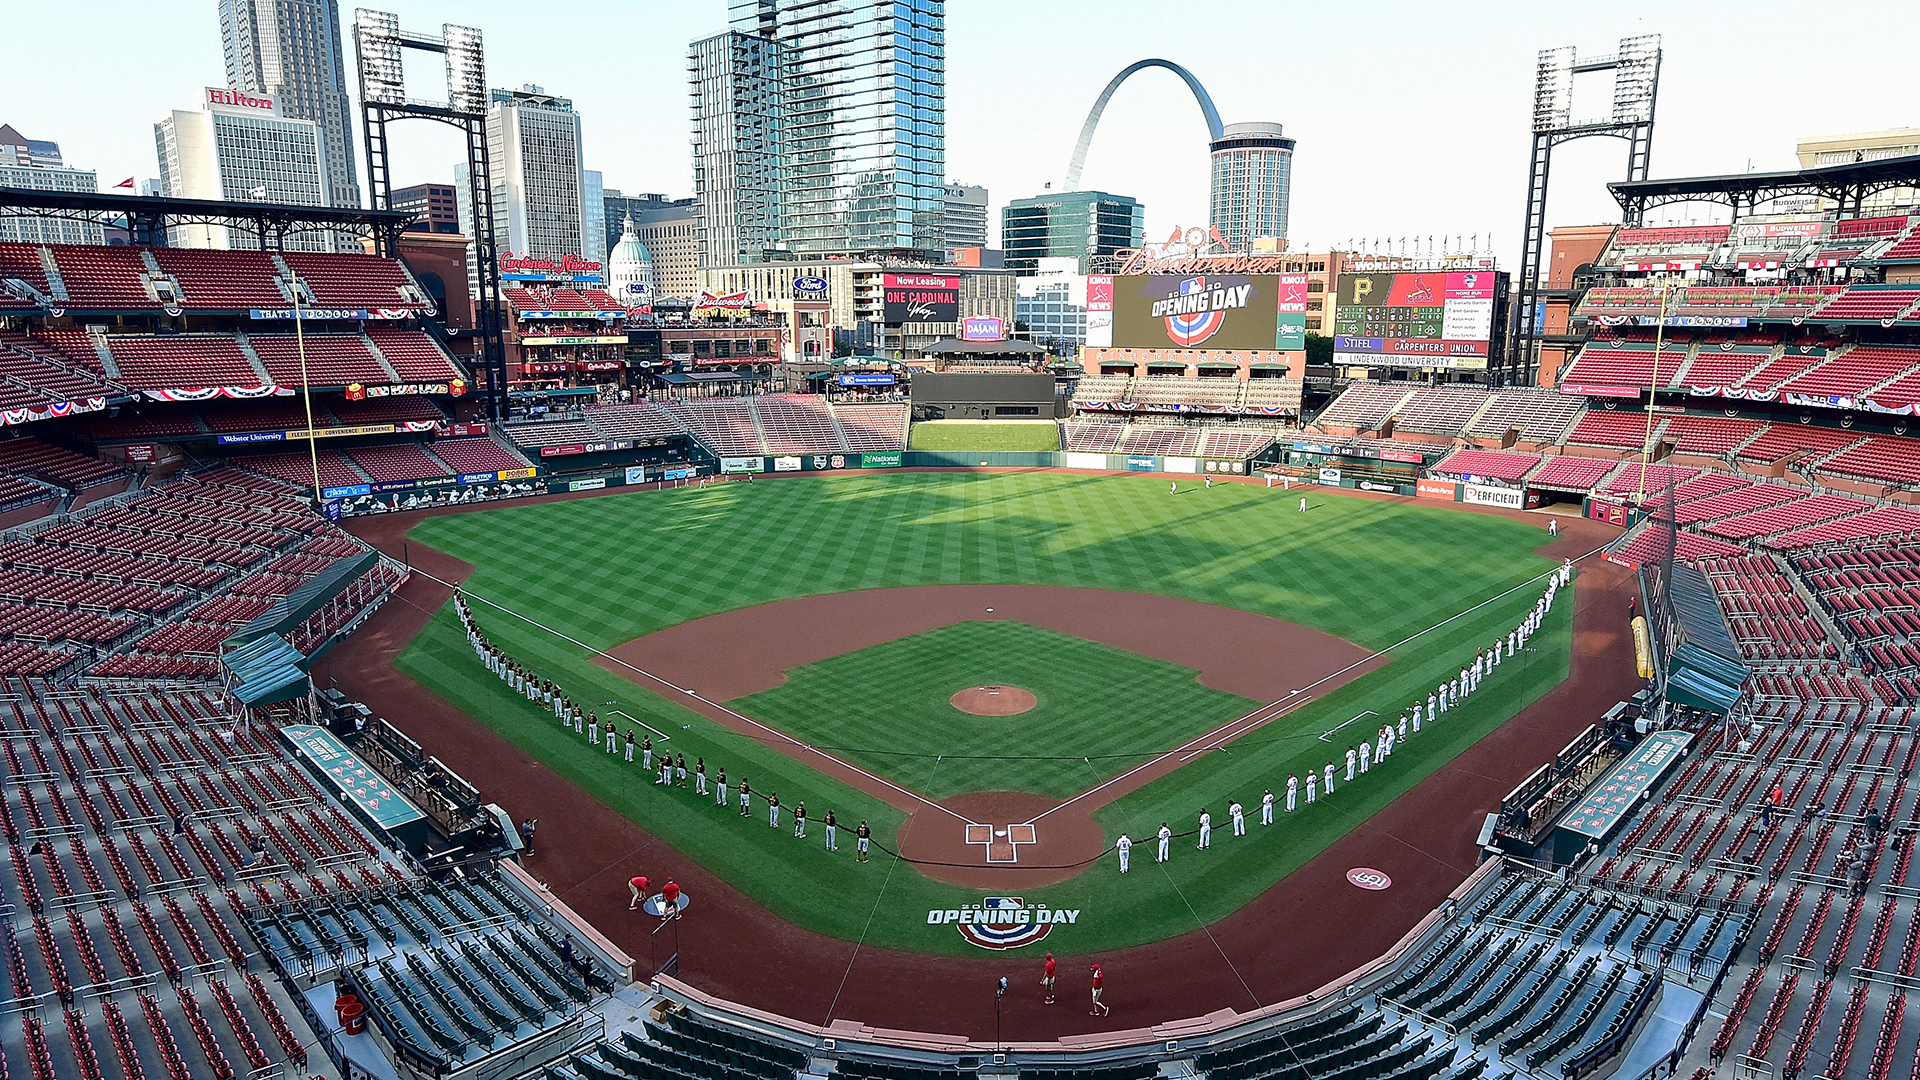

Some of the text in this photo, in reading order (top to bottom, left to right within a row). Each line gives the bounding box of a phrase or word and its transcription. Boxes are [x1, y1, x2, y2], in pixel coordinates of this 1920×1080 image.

[209, 90, 272, 109] Hilton
[1773, 199, 1819, 207] BUDWEISER
[1769, 224, 1816, 232] BUDWEISER
[500, 251, 601, 273] Cardinals Nation
[1113, 248, 1284, 276] Budweiser
[1354, 260, 1399, 271] WORLD
[800, 277, 822, 290] Ford
[896, 276, 946, 288] Now Leasing
[1089, 276, 1111, 285] KMOX
[1281, 276, 1306, 285] KMOX
[1206, 282, 1222, 291] 20
[887, 291, 956, 304] ONE CARDINAL
[1151, 283, 1251, 318] OPENING DAY
[1168, 291, 1179, 299] 20
[692, 294, 750, 309] Budweiser
[1088, 302, 1111, 311] NEWS
[1280, 302, 1305, 312] NEWS
[259, 310, 291, 318] THAT'S
[692, 308, 750, 318] BREW HOUSE
[907, 298, 937, 320] Way
[967, 322, 999, 335] DASANI
[1343, 337, 1373, 349] STIFEL
[1394, 342, 1476, 353] CARPENTERS UNION
[1130, 352, 1137, 361] 6
[1142, 352, 1149, 361] 9
[1154, 353, 1163, 361] 10
[1167, 353, 1177, 361] 14
[1182, 353, 1192, 362] 17
[1213, 354, 1226, 363] 24
[1231, 354, 1243, 363] 42
[1248, 354, 1260, 363] 45
[1266, 355, 1278, 363] 85
[1350, 355, 1400, 365] LINDENWOOD
[1402, 357, 1451, 367] UNIVERSITY
[1563, 386, 1577, 394] Mercy
[223, 432, 282, 443] Webster University
[325, 428, 357, 436] CONVENIENCE
[872, 454, 899, 463] National
[463, 473, 492, 481] ATHLETICO
[579, 480, 604, 488] Ameritrade
[1464, 487, 1520, 505] PERFICIENT
[927, 910, 1080, 924] OPENING DAY
